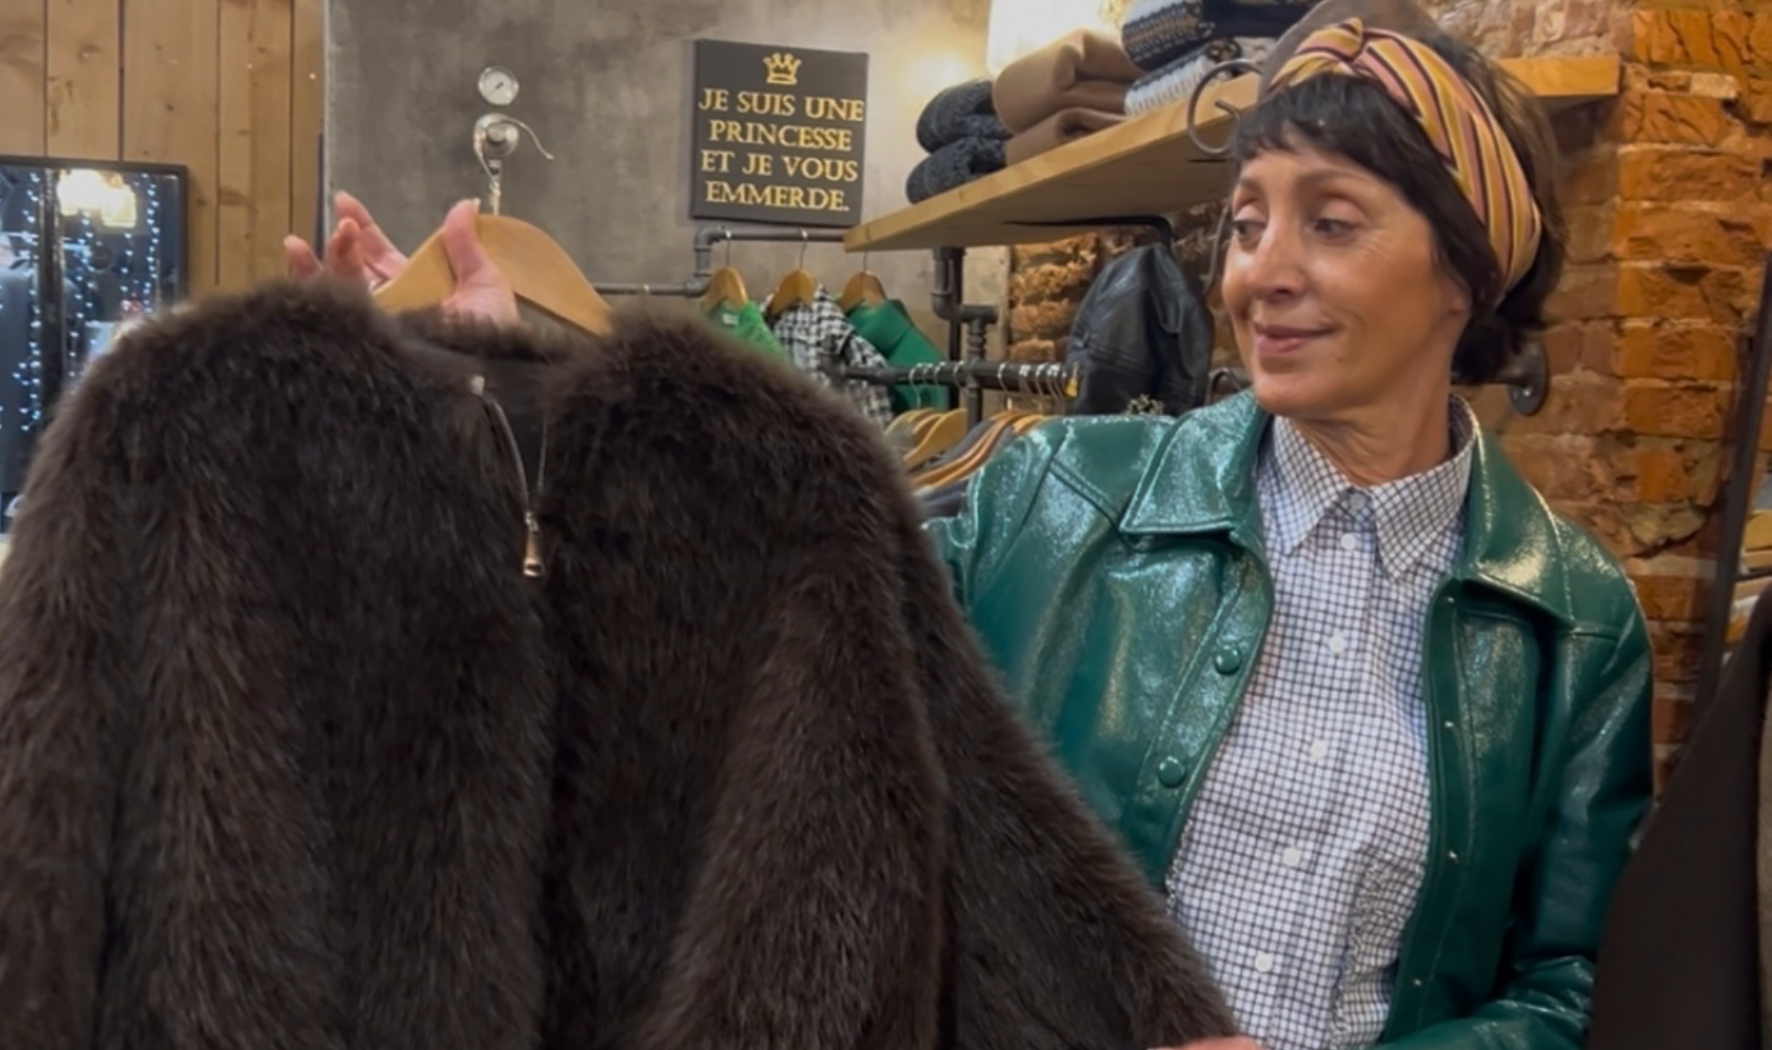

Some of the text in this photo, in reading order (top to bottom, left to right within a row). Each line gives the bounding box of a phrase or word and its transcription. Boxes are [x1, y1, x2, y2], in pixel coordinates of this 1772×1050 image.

[698, 88, 864, 122] JE SUIS UNE
[709, 120, 853, 151] PRINCESSE
[701, 150, 859, 182] ET JE VOUS
[705, 180, 850, 212] EMMERDE.
